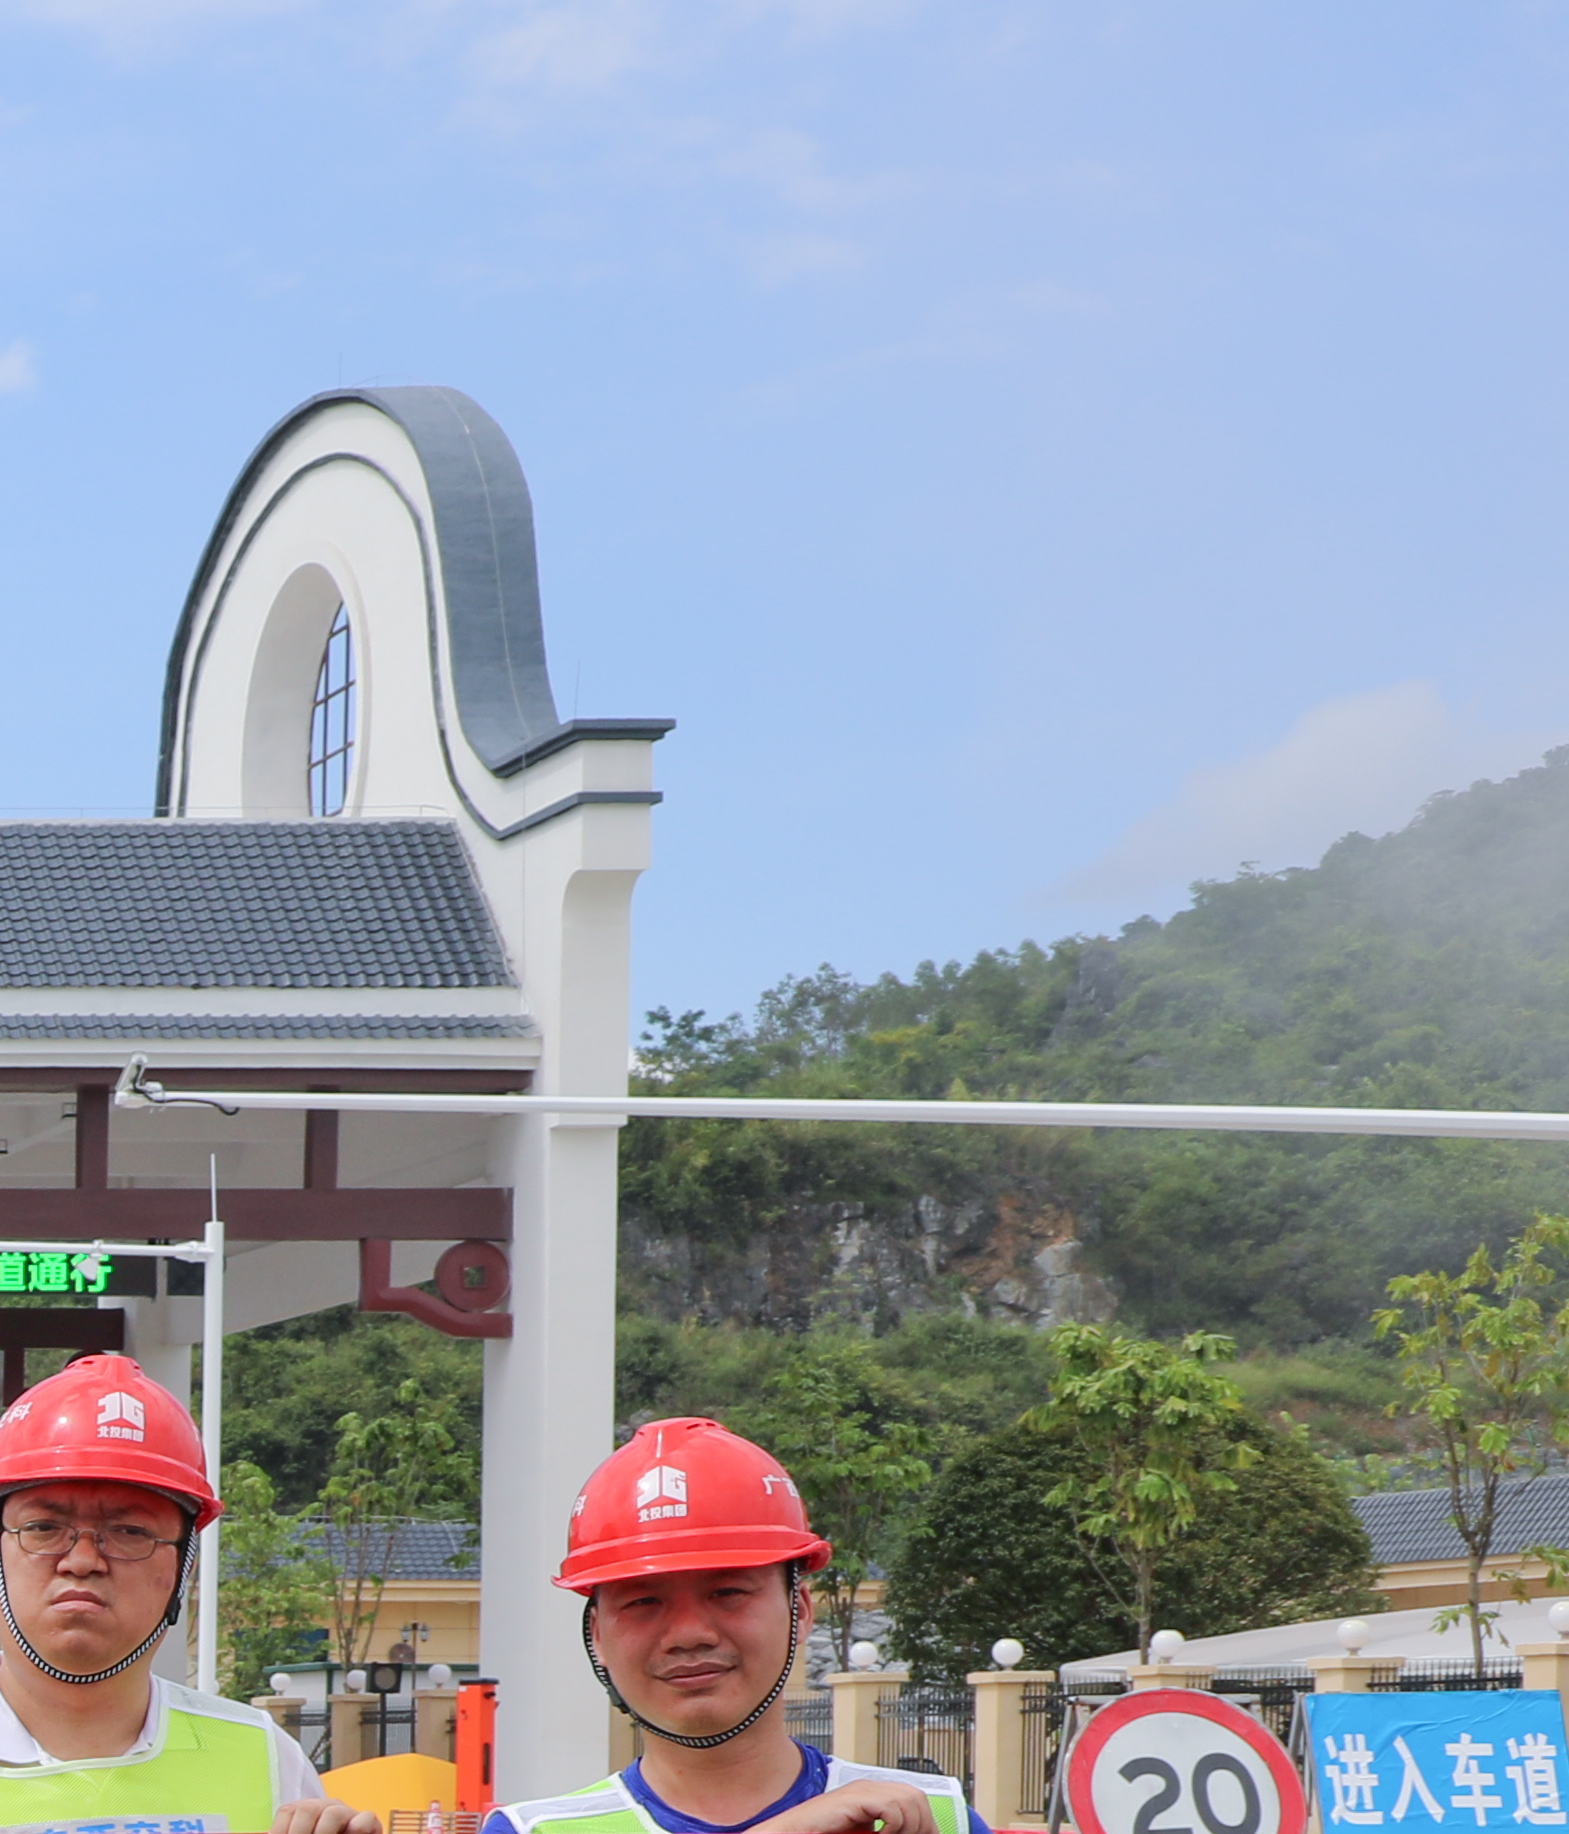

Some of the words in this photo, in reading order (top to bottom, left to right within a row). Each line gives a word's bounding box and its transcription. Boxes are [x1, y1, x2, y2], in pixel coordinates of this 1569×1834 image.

[96, 1425, 145, 1443] 北投集团
[637, 1503, 688, 1523] 北投集团
[1323, 1732, 1568, 1827] 进入车道
